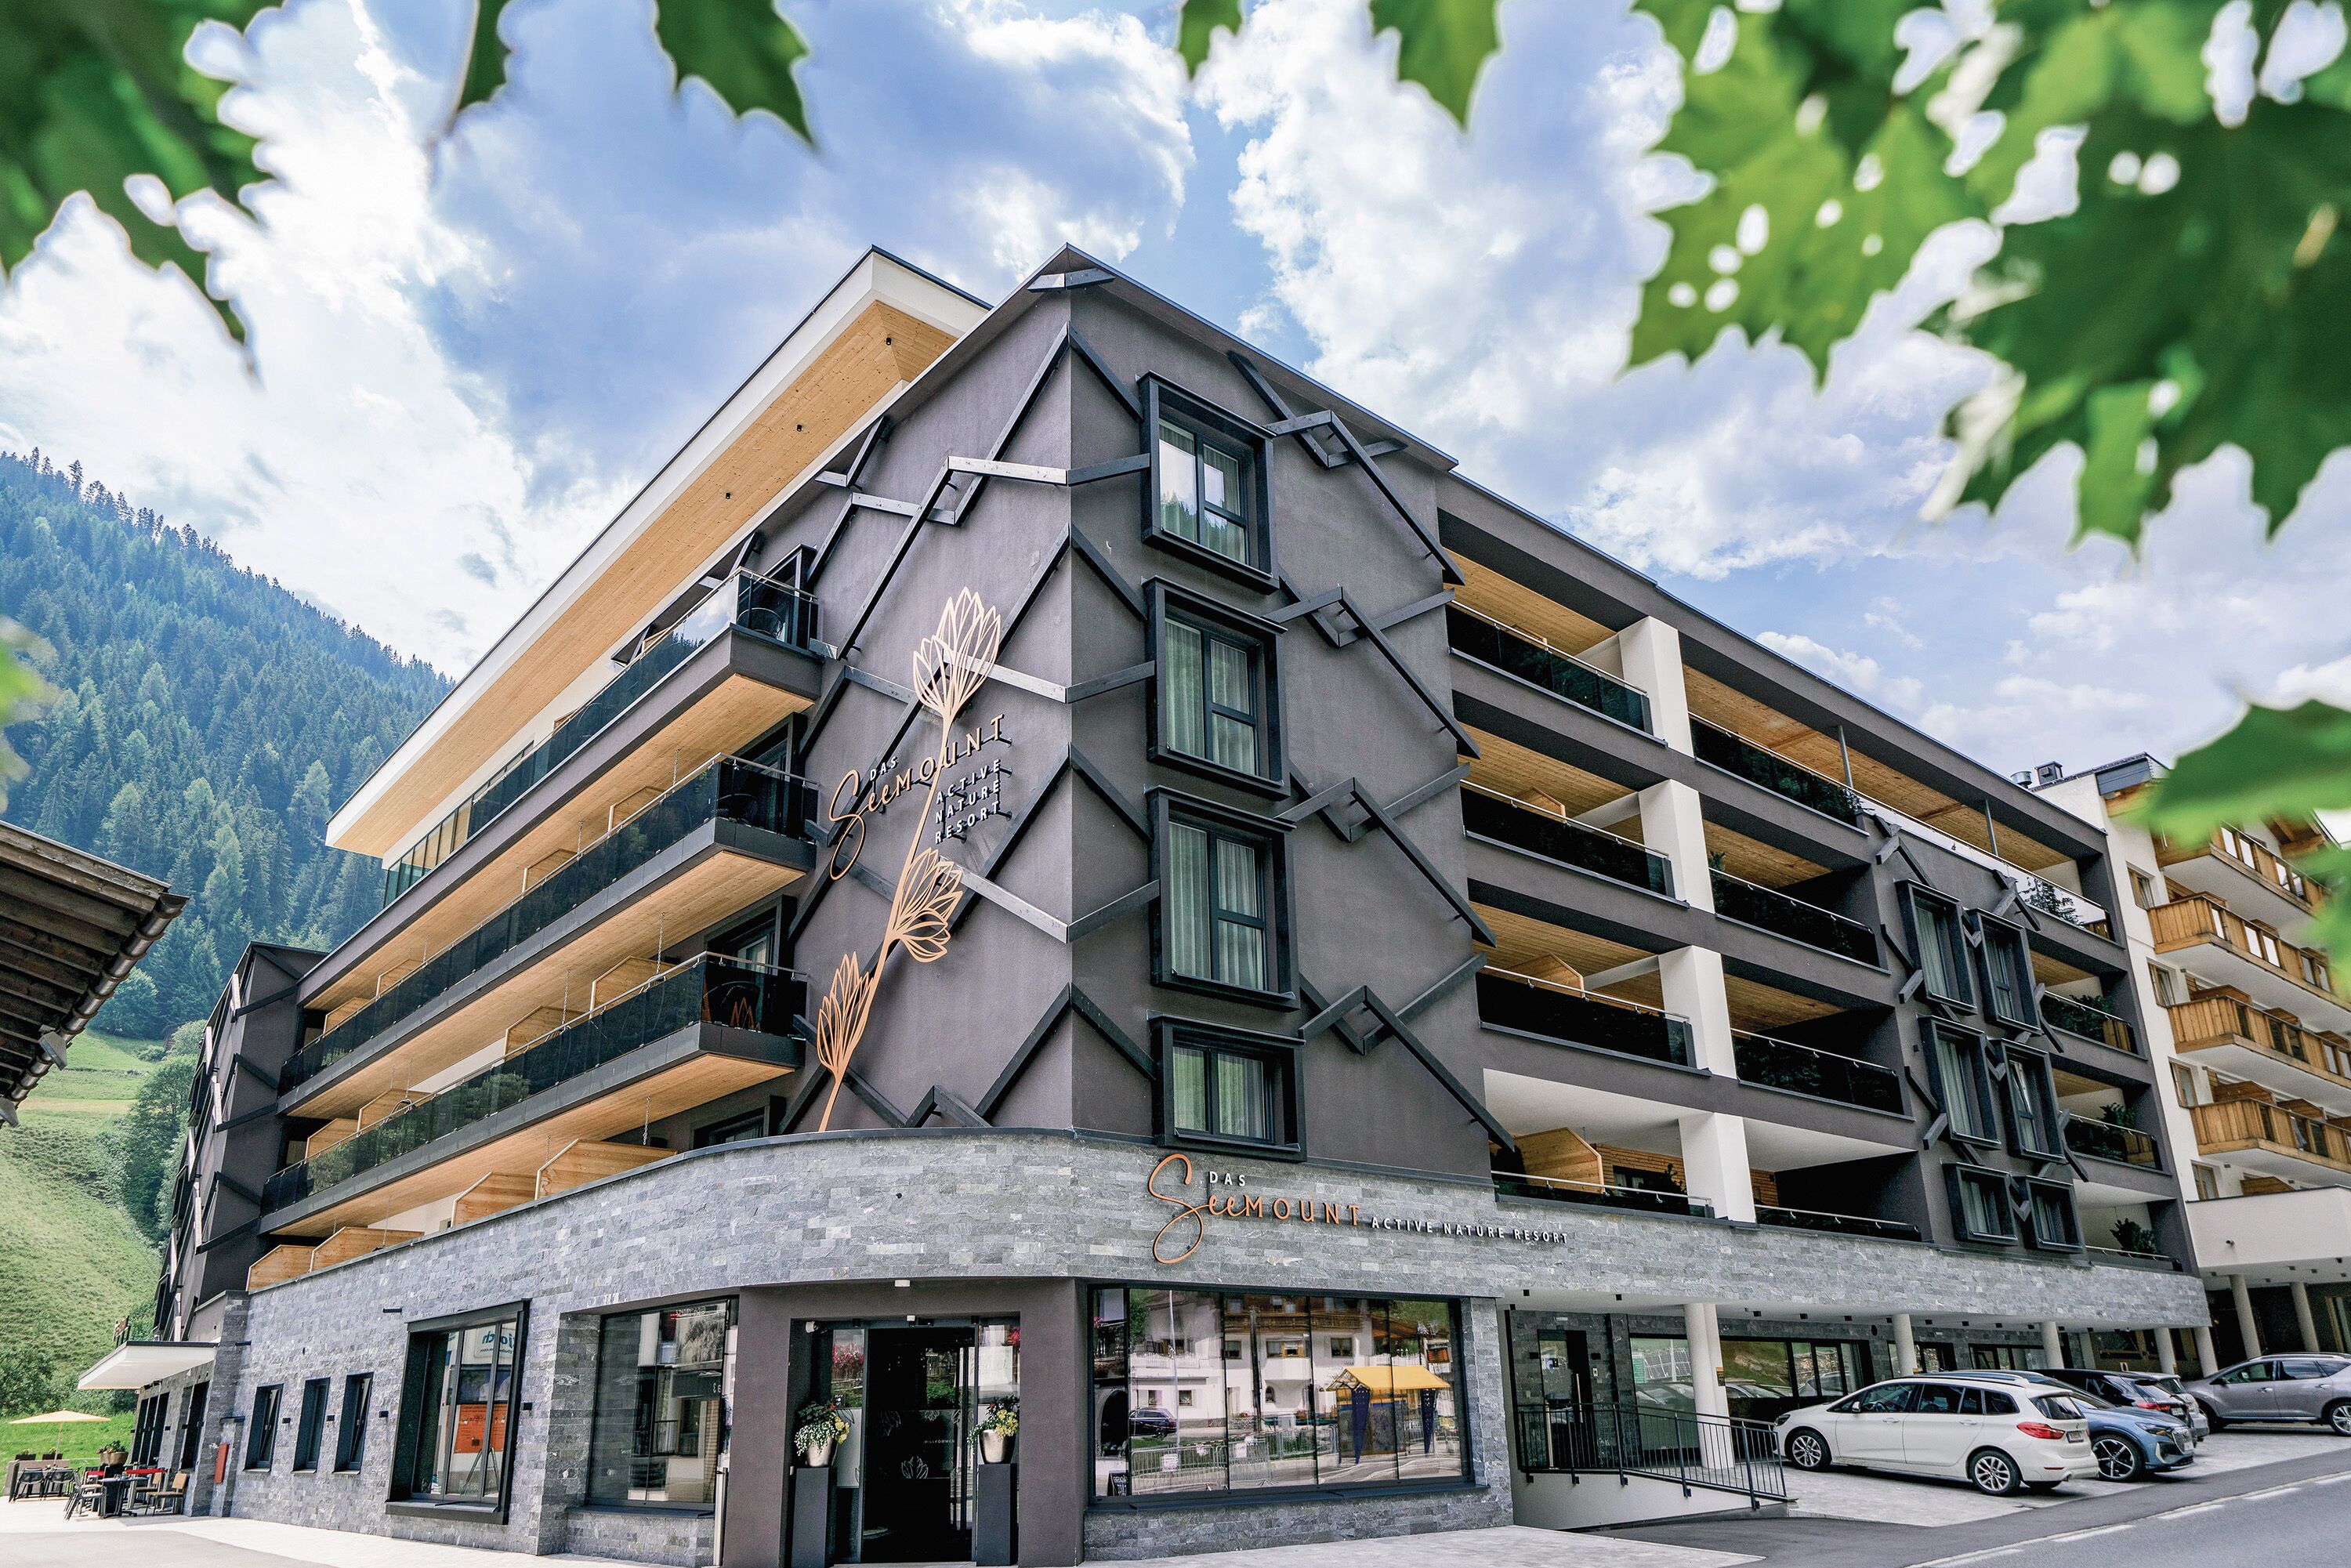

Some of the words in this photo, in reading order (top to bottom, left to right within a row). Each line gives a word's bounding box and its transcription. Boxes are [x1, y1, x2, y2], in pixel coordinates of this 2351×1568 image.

[869, 755, 899, 782] DAS
[935, 758, 1002, 804] ACTIVE
[934, 778, 1002, 825] NATURE
[934, 799, 1001, 846] RESORT
[1208, 1171, 1247, 1187] DAS
[1371, 1215, 1434, 1234] ACTIVE
[1444, 1222, 1505, 1240] NATURE
[1513, 1228, 1569, 1244] RESORT
